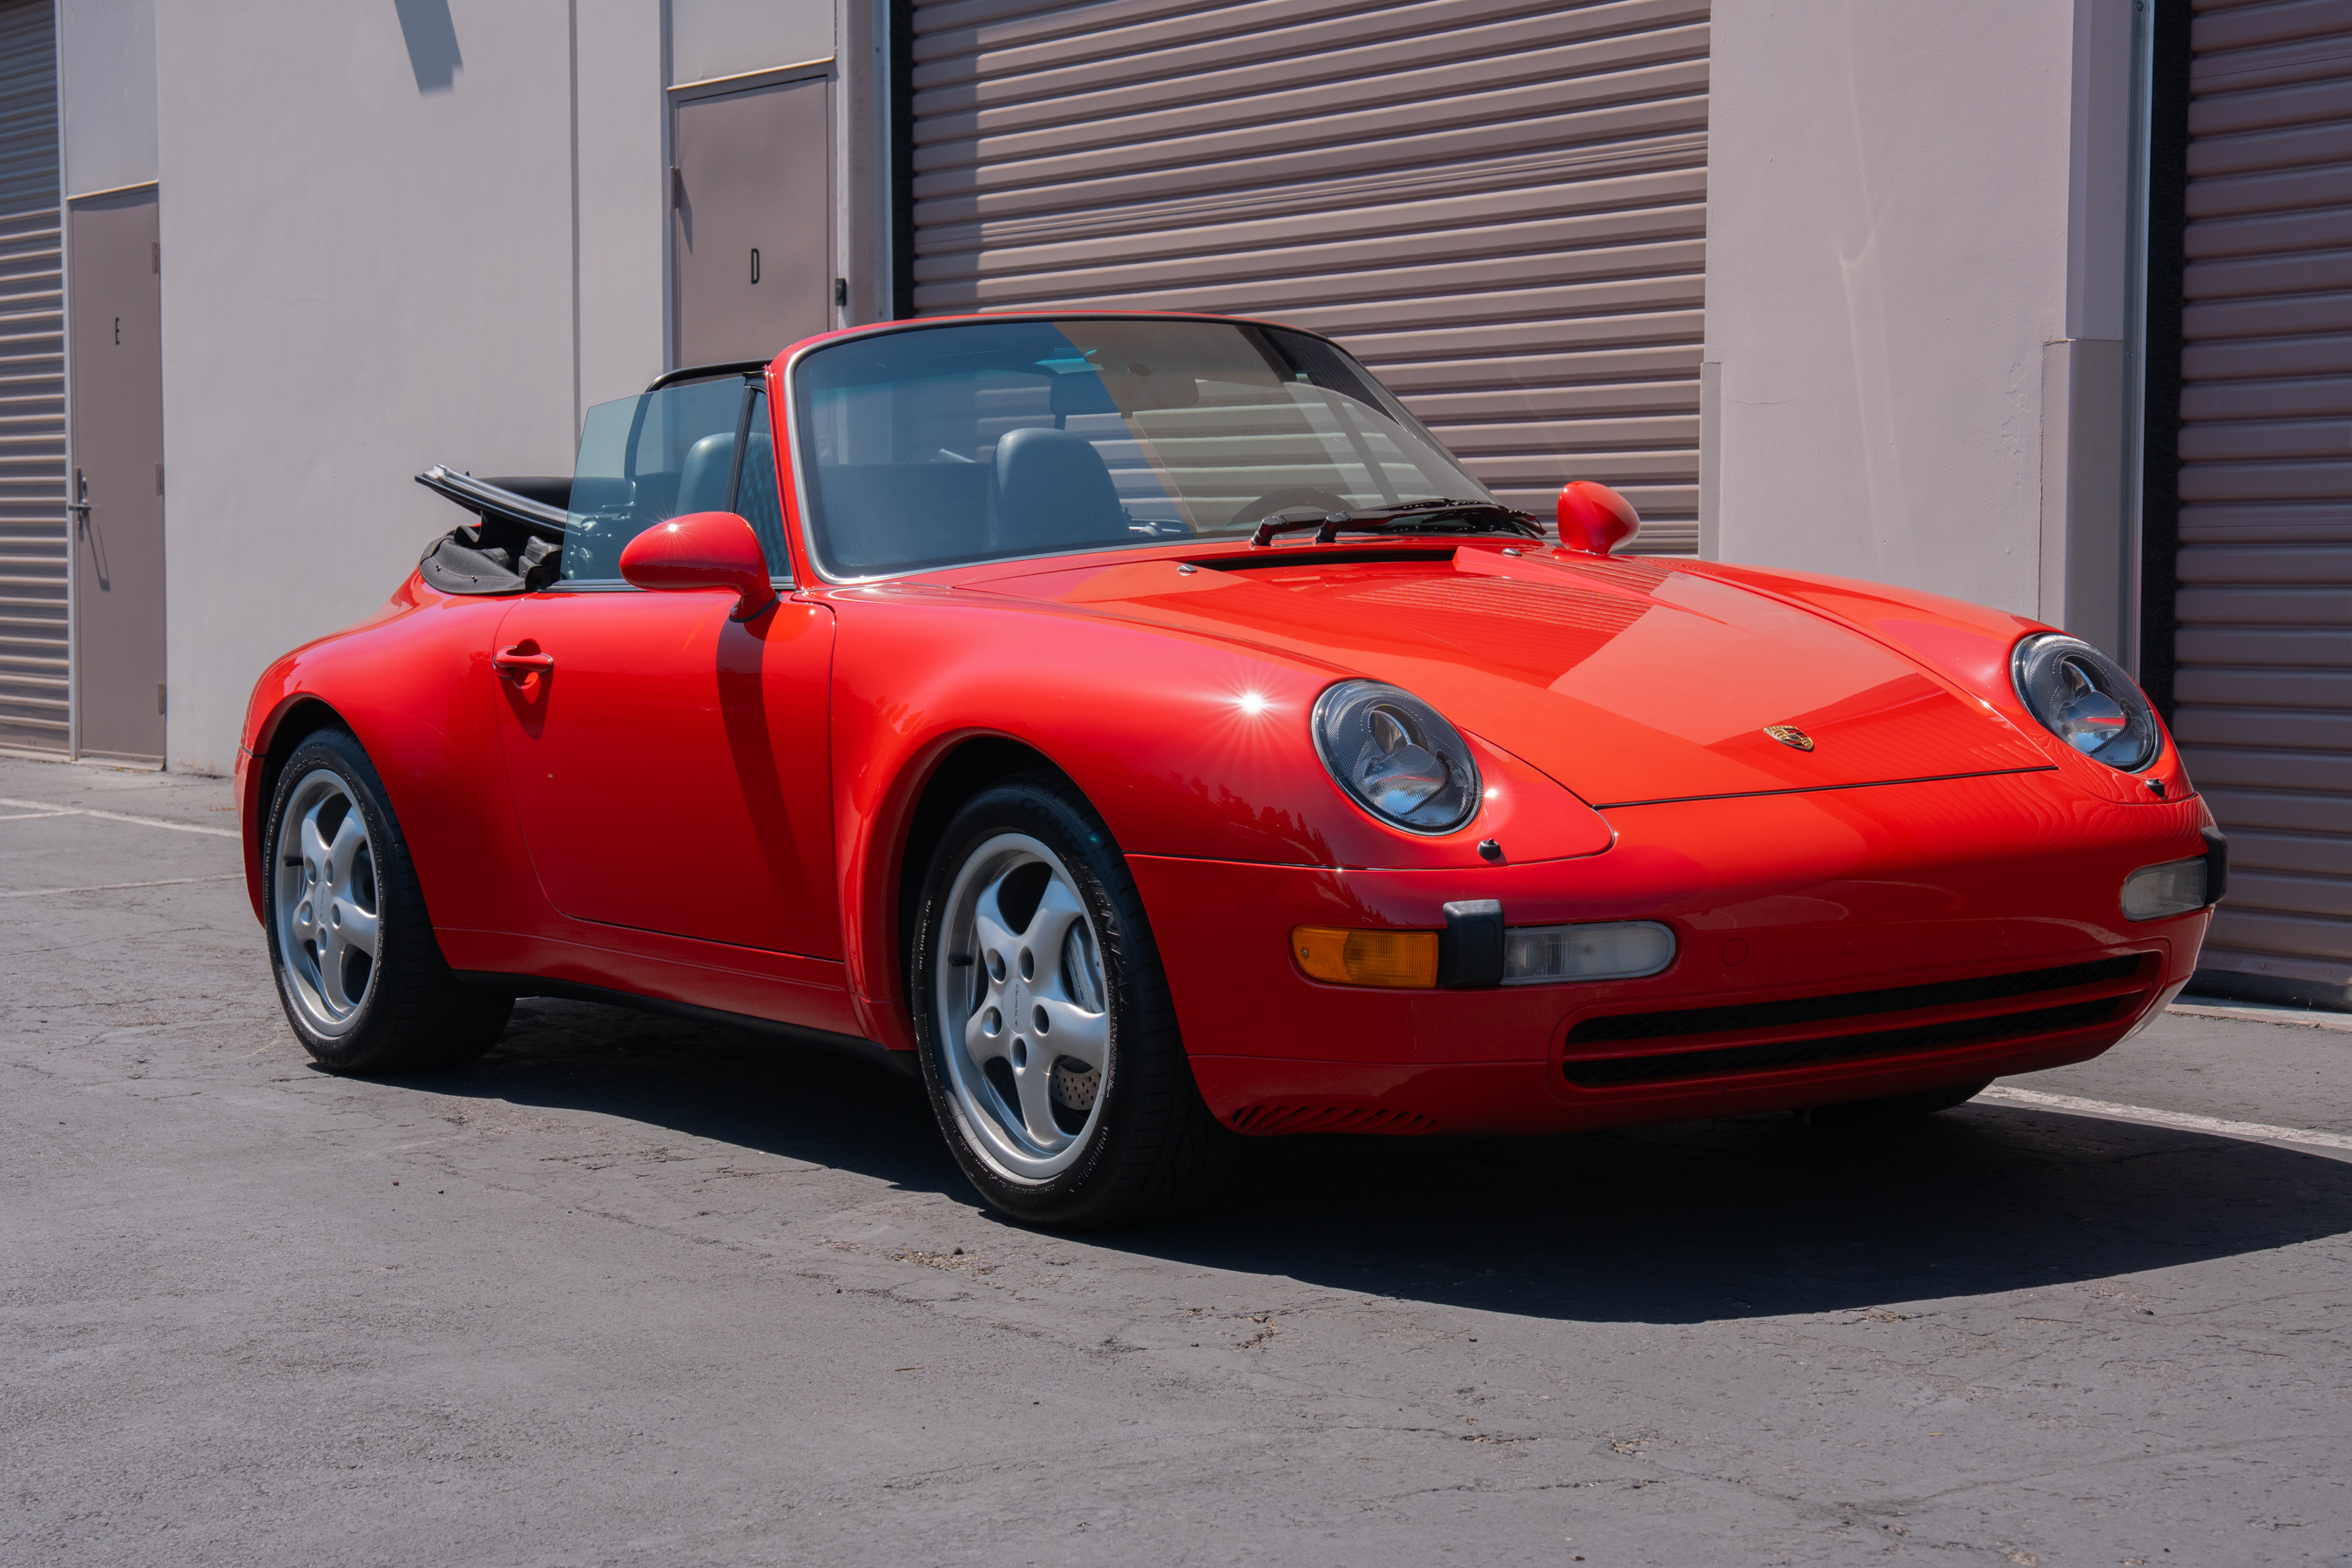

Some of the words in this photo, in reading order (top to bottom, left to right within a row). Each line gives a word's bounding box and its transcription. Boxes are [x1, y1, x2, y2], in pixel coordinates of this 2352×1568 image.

[751, 248, 760, 285] D
[115, 318, 119, 345] E
[1067, 947, 1085, 1001] PORSCHE
